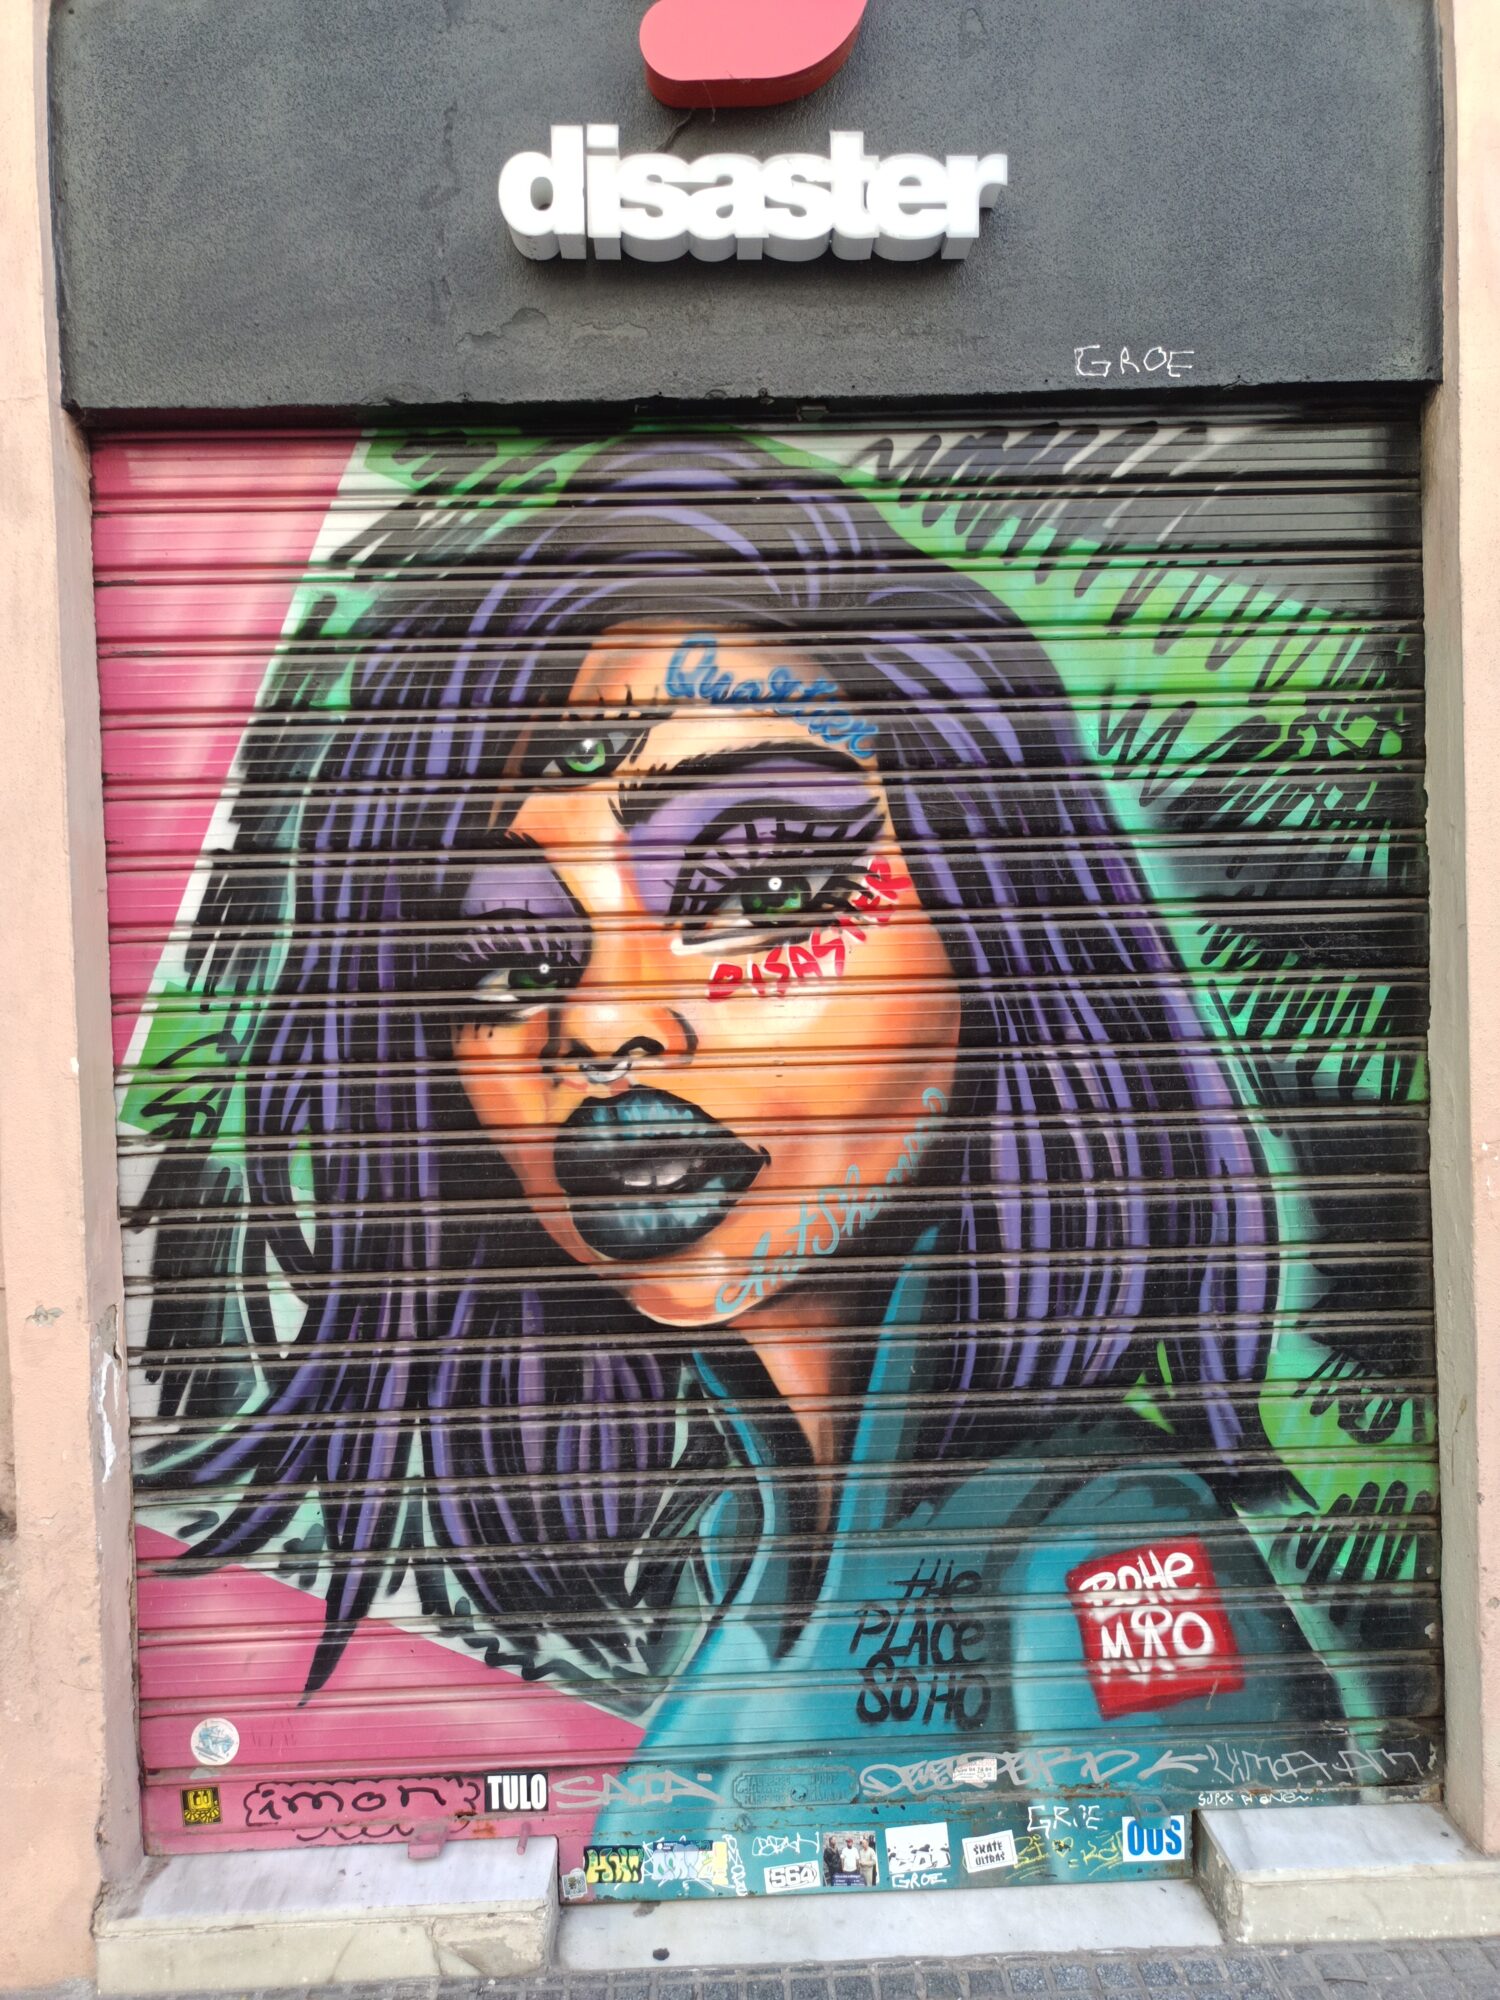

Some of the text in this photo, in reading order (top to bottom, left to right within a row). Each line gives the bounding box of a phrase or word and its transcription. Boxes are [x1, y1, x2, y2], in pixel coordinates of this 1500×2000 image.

[498, 123, 1008, 242] disaster
[1074, 344, 1195, 378] GROE
[487, 1773, 547, 1810] TULO
[973, 1840, 1003, 1855] SKATE
